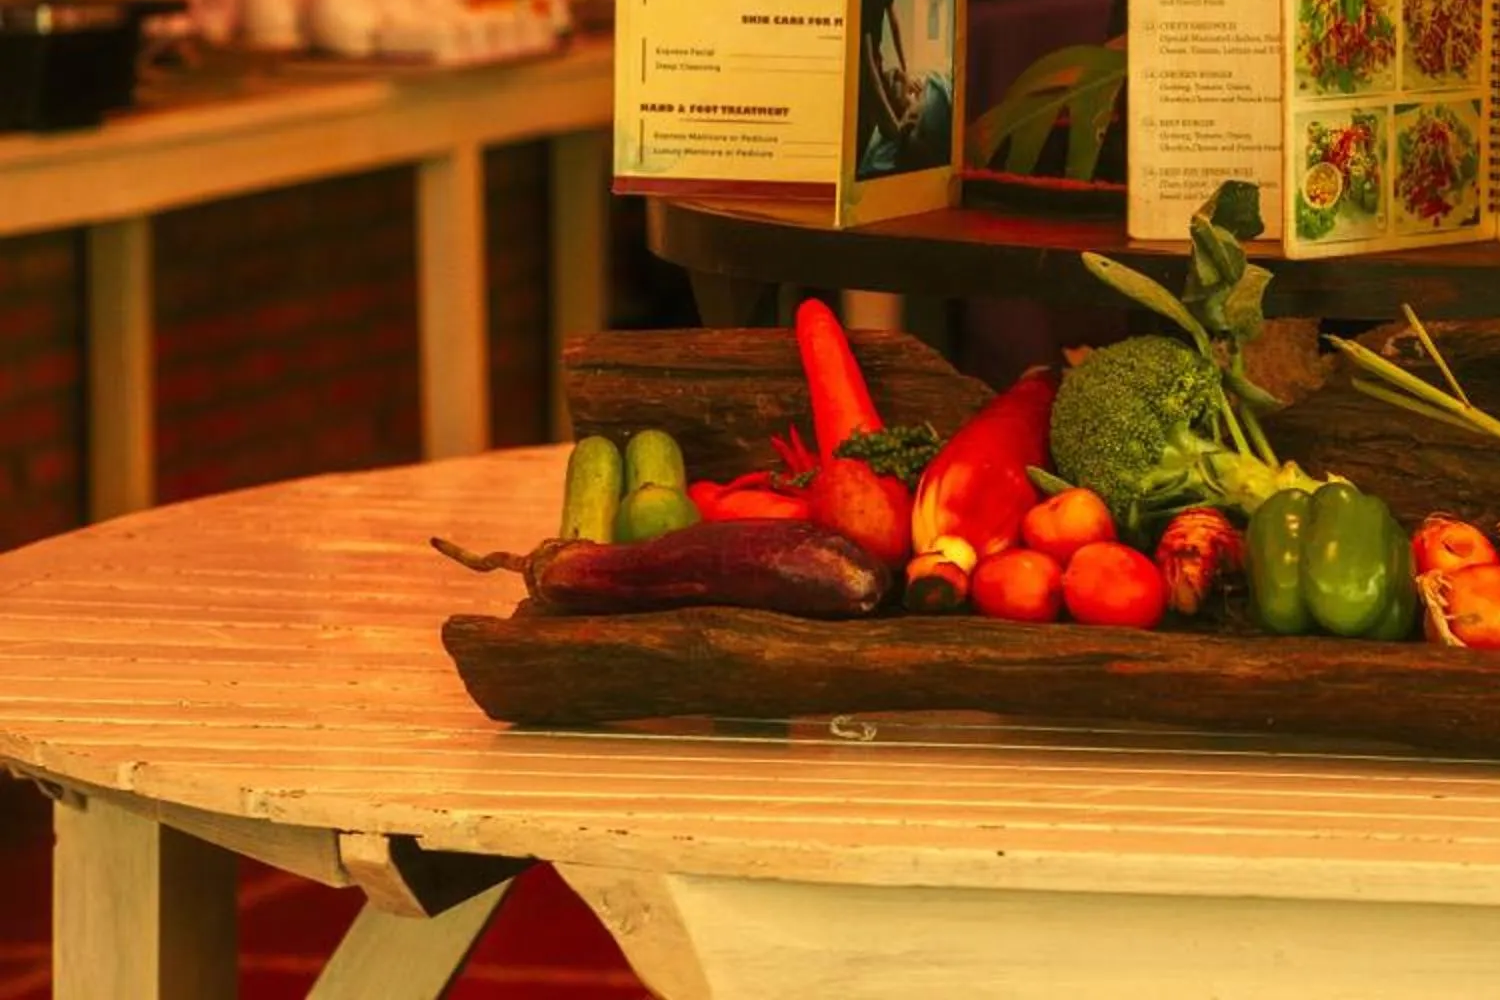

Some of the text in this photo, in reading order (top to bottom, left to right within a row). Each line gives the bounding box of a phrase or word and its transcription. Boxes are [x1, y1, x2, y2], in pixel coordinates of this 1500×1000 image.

[774, 16, 804, 26] CARE
[808, 16, 831, 26] FOR
[689, 105, 718, 115] FOOT
[720, 106, 790, 116] TREATMENT
